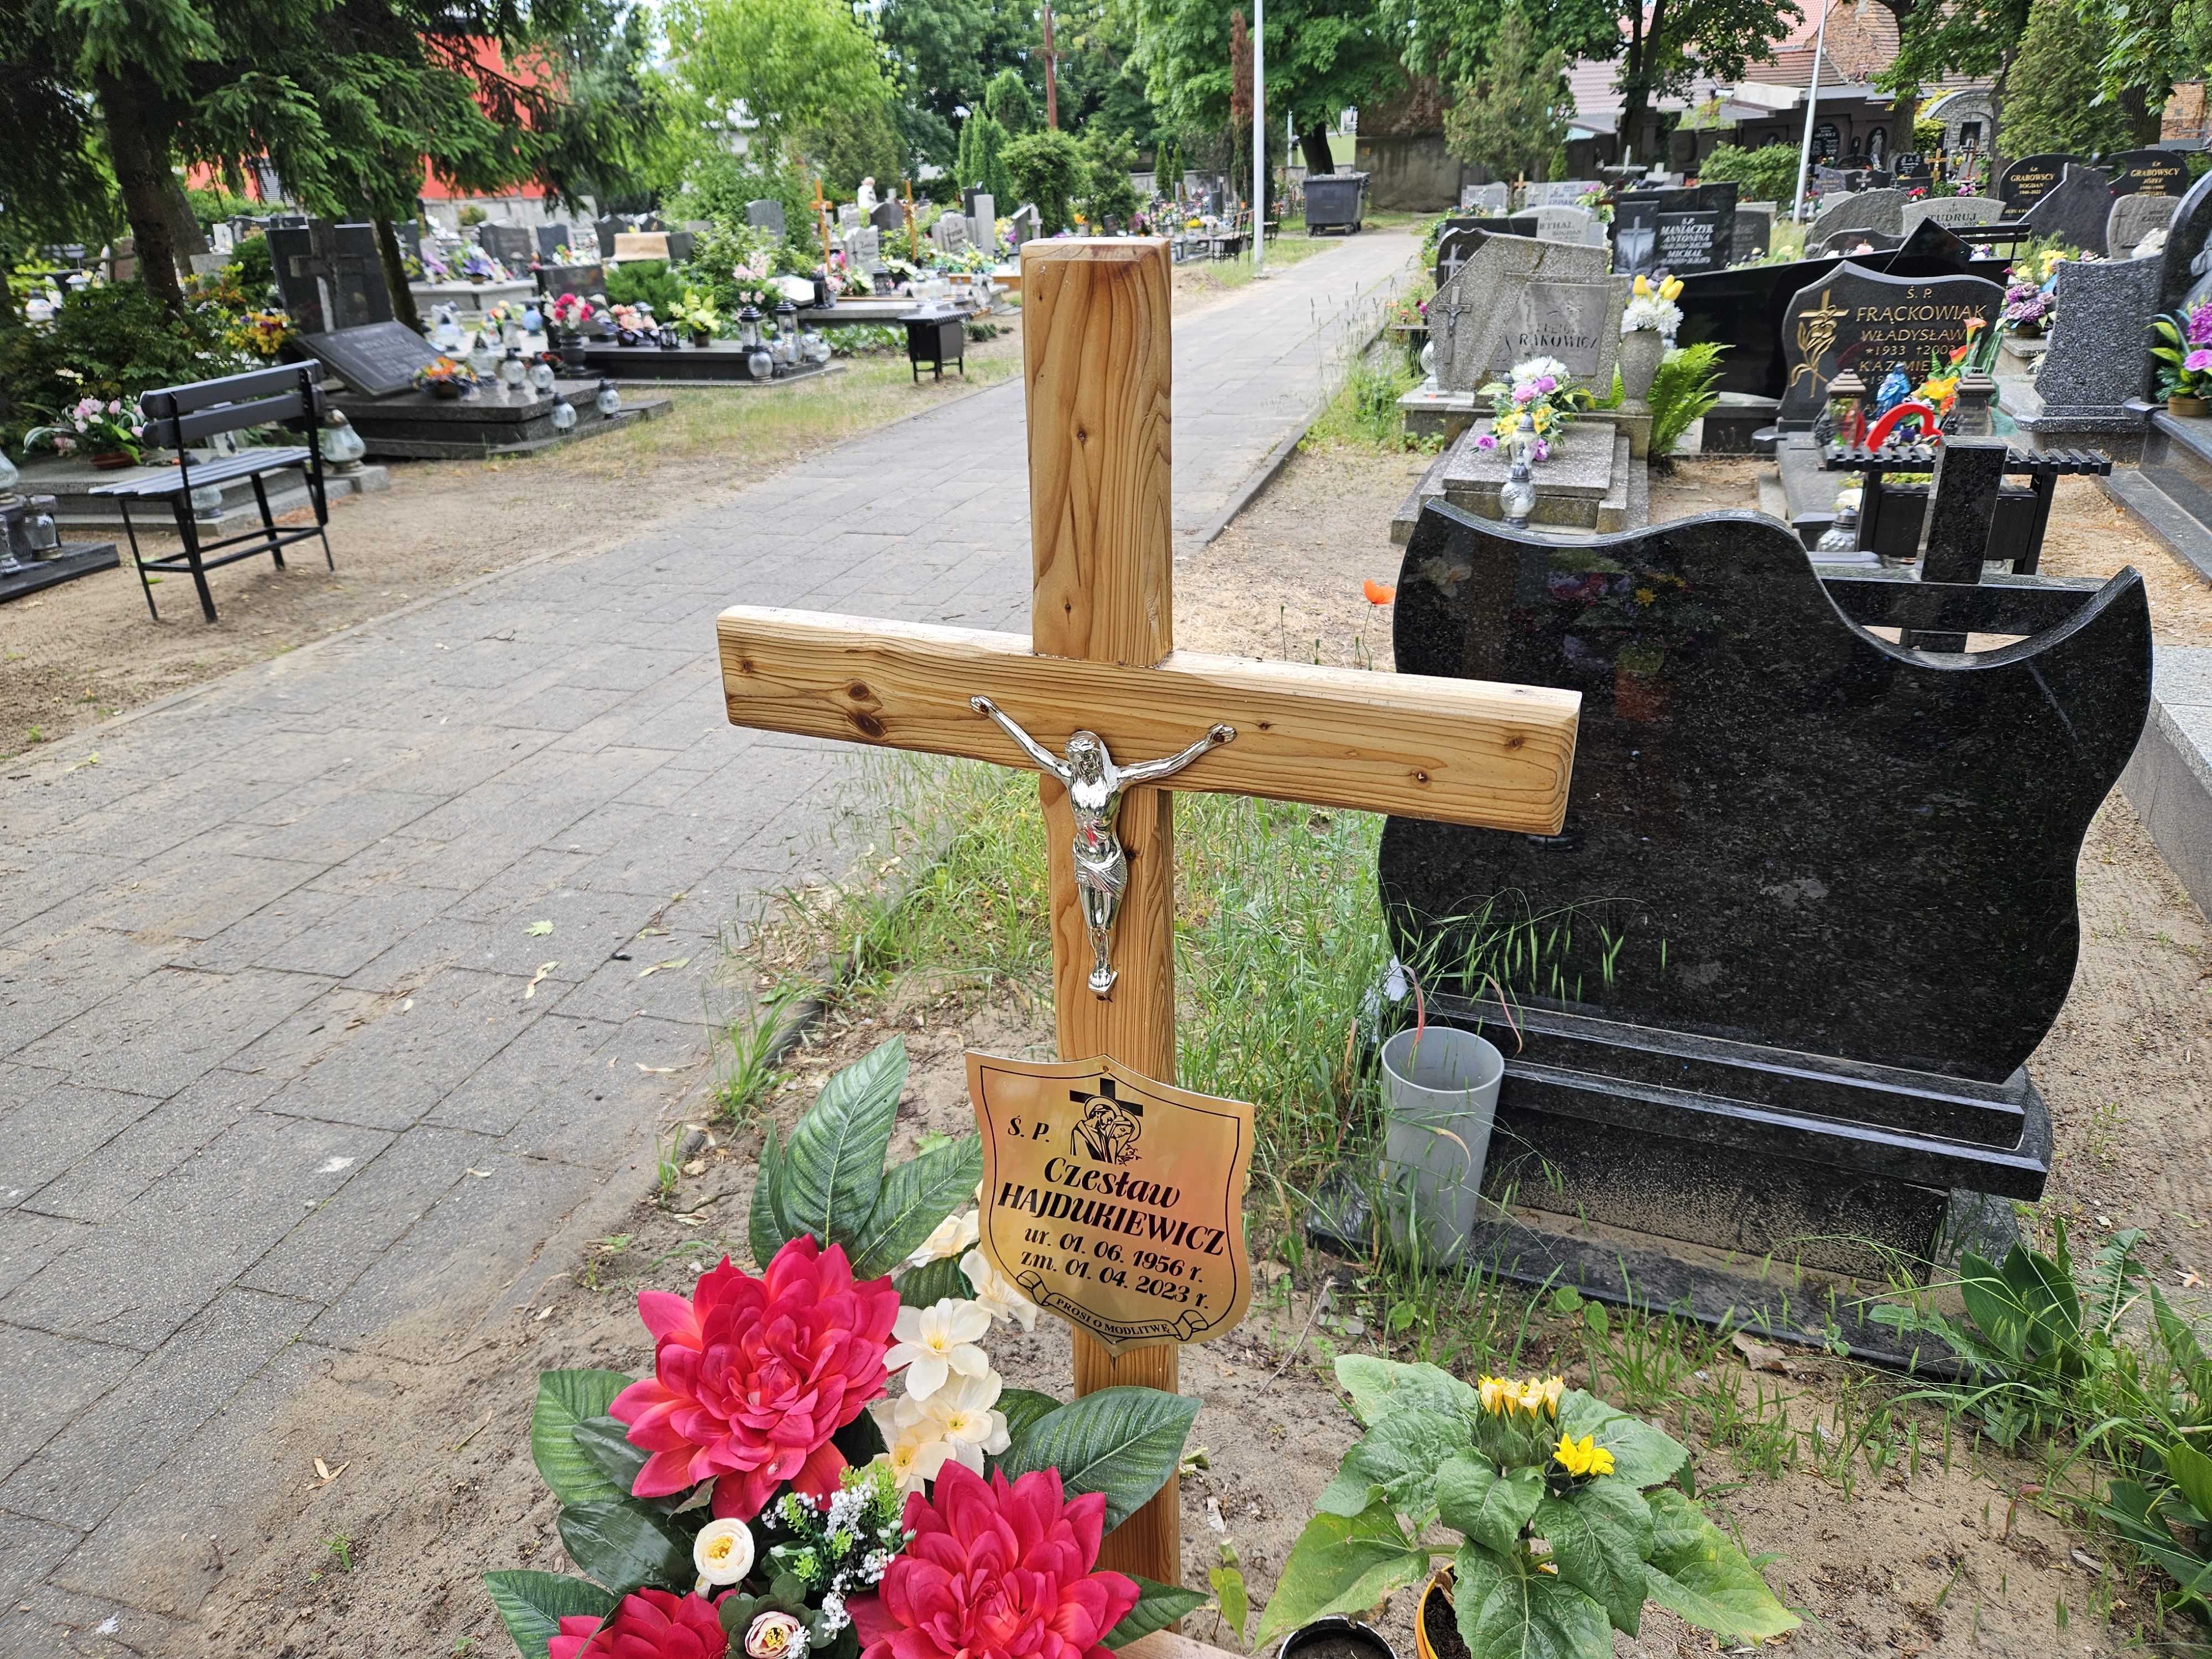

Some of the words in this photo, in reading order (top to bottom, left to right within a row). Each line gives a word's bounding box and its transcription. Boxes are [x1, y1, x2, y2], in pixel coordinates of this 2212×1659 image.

[2010, 173, 2056, 182] GRABOWSCY
[2130, 168, 2180, 177] GRABOWSCY
[1856, 305, 1987, 325] FRĄCKOWIAK
[1861, 329, 1966, 341] WŁADYSŁAW
[1008, 1115, 1025, 1138] Ś.
[1032, 1122, 1050, 1142] P.
[1044, 1157, 1180, 1208] Czesław
[998, 1182, 1225, 1256] HAJDUKIEWICZ
[1024, 1228, 1051, 1246] ur.
[1059, 1233, 1086, 1254] 01.
[1093, 1241, 1124, 1263] 06.
[1133, 1250, 1186, 1276] 1956
[1190, 1265, 1203, 1283] r.
[1020, 1251, 1057, 1272] zm.
[1065, 1259, 1092, 1280] 01.
[1099, 1267, 1128, 1288] 04.
[1135, 1275, 1191, 1303] 2023
[1196, 1292, 1209, 1309] r.
[1056, 1297, 1091, 1322] PROSI
[1093, 1319, 1103, 1328] O
[1104, 1323, 1171, 1335] MODLITWĘ
